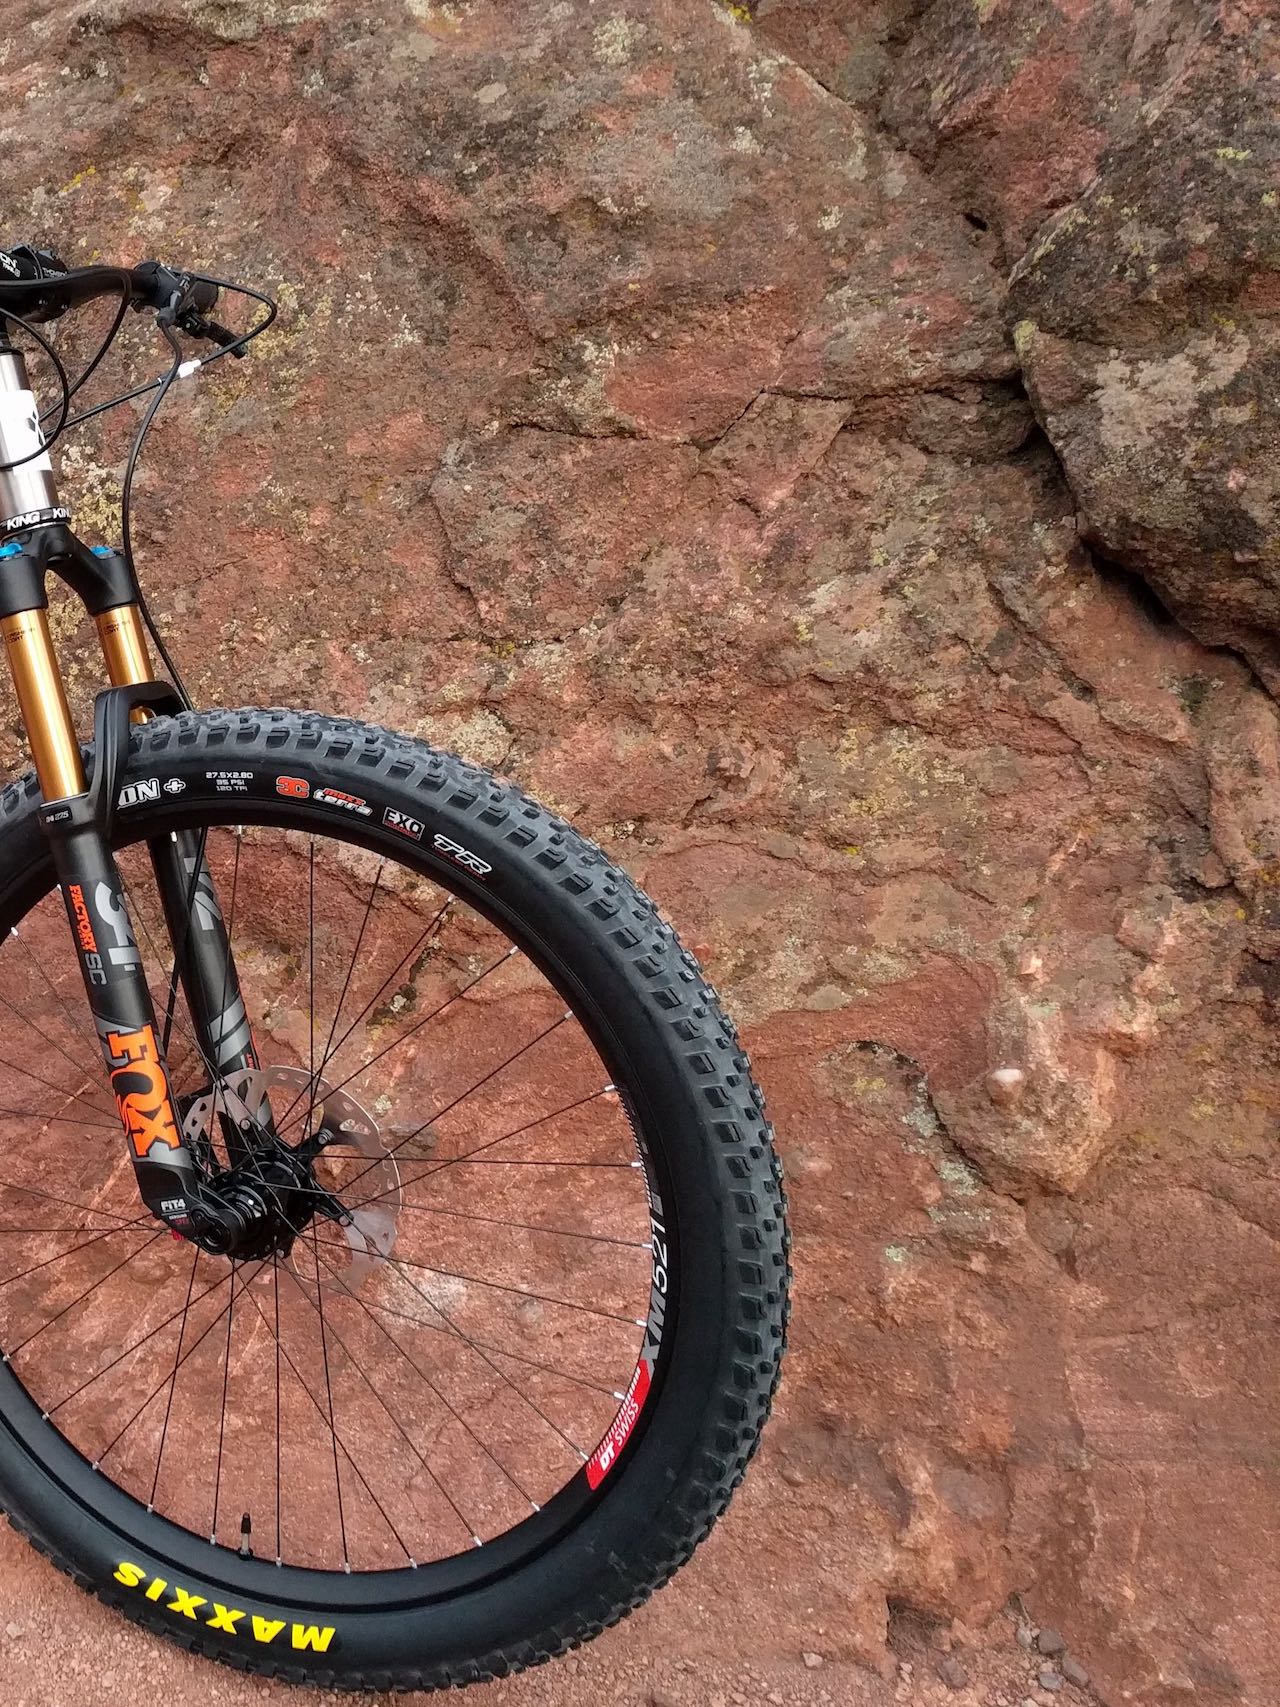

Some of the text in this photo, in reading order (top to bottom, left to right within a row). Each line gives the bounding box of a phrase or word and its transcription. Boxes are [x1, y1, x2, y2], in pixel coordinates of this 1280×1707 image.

[6, 511, 41, 531] KING
[52, 507, 70, 519] KIN
[205, 771, 254, 779] 27.5X2.80
[275, 775, 310, 799] 3C
[117, 777, 161, 809] ON
[313, 788, 373, 817] terra
[384, 810, 423, 836] EXO
[433, 833, 493, 875] TR
[68, 884, 107, 985] FACTORY SC
[105, 1023, 182, 1157] FOX
[160, 1198, 186, 1212] FIT4
[641, 1213, 669, 1382] XM521
[599, 1399, 639, 1472] DT SWISS
[112, 1561, 336, 1653] MAXXIS
